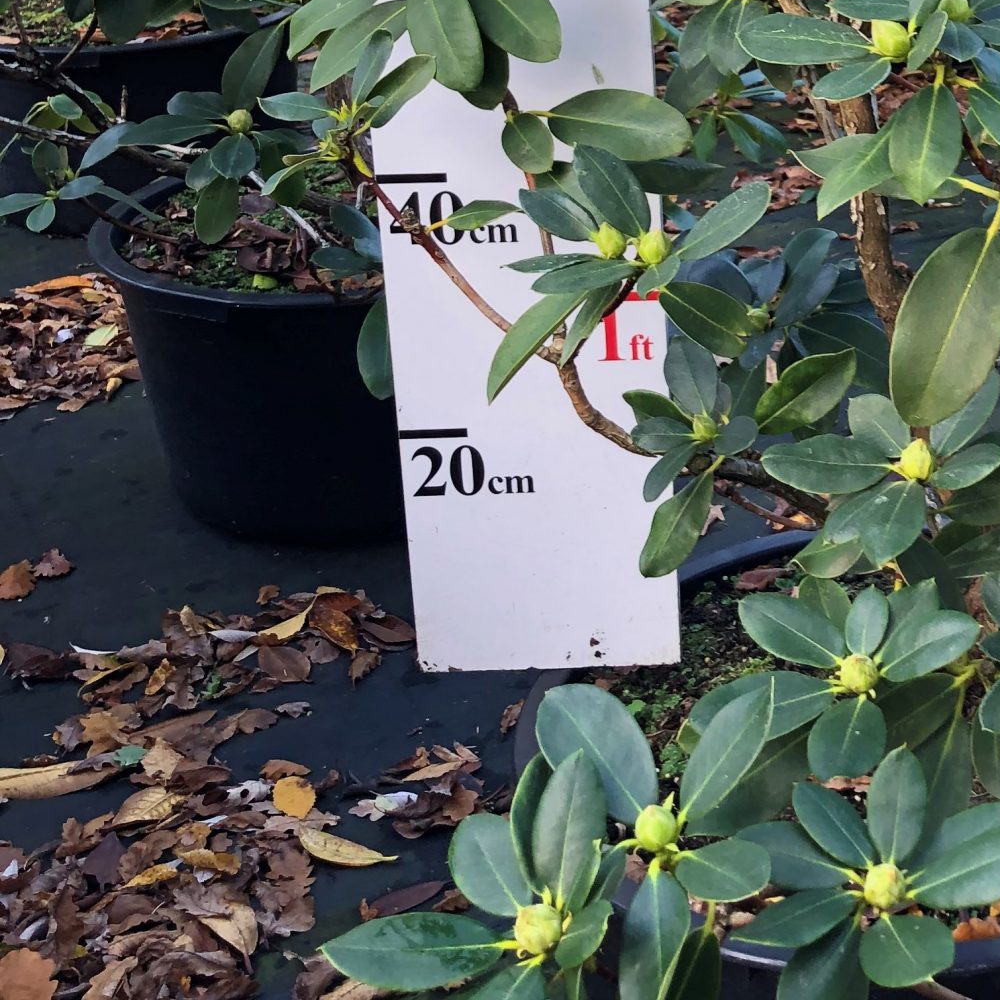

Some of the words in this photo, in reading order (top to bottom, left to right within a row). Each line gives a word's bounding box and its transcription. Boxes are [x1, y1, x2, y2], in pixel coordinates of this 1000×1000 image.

[389, 190, 519, 246] 40cm
[597, 310, 654, 362] 1ft
[411, 444, 536, 497] 20cm
